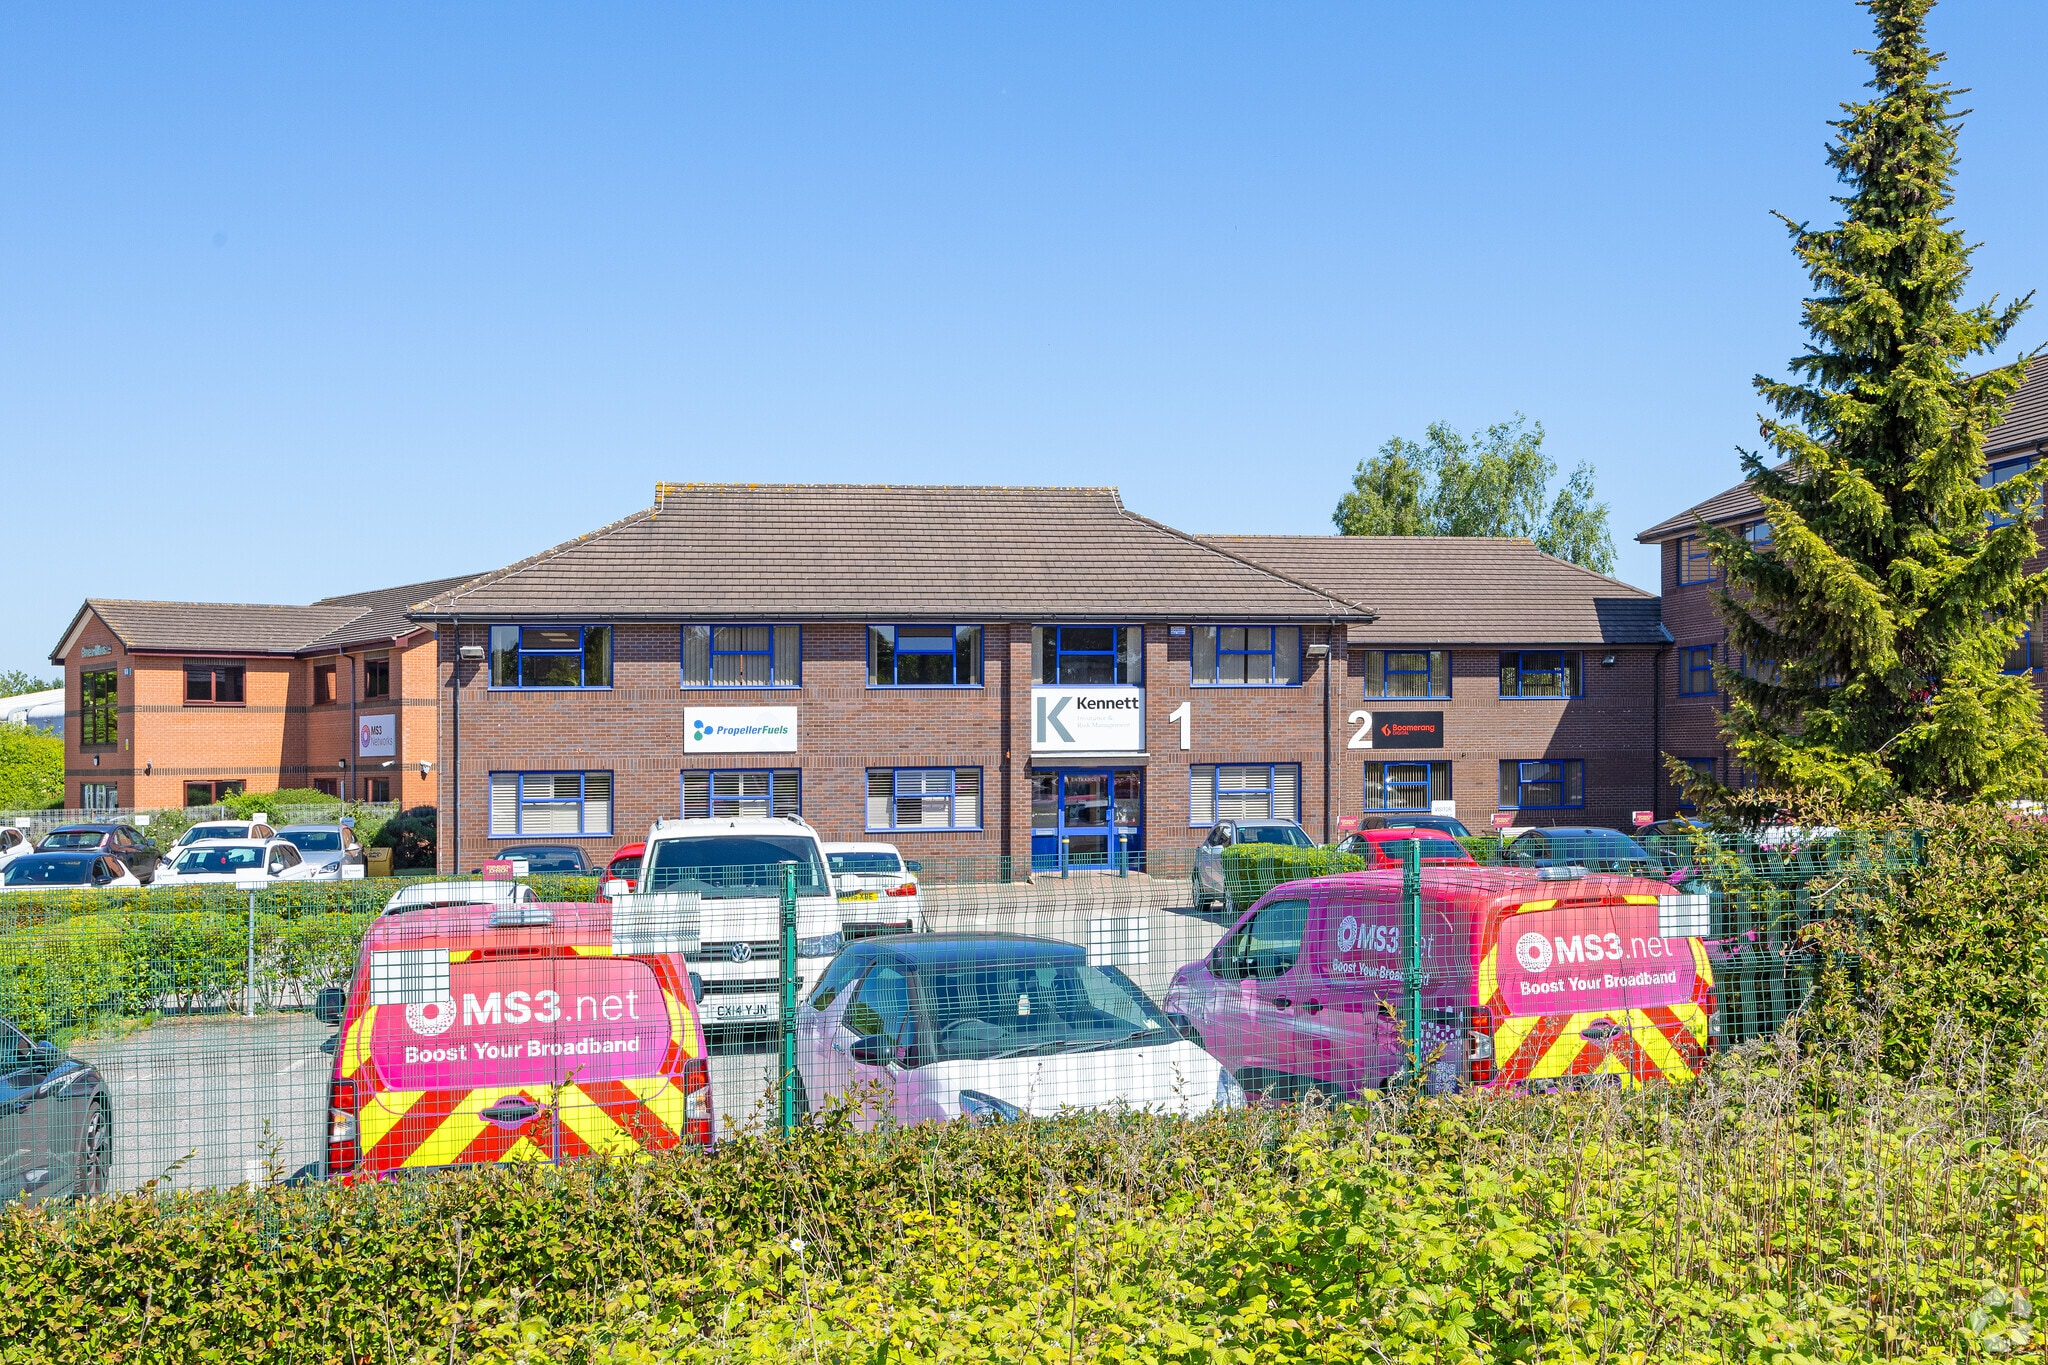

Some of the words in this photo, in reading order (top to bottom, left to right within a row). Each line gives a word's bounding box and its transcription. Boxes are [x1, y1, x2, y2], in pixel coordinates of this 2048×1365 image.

[1077, 697, 1139, 709] Kennett
[371, 725, 383, 735] MS3
[716, 725, 789, 736] PropellerFuels
[1037, 697, 1076, 743] K
[1169, 702, 1191, 750] 1
[1347, 710, 1373, 749] 2
[1392, 724, 1435, 732] Boomerang
[371, 737, 393, 746] Networks
[1357, 923, 1435, 958] MS3.et
[1554, 932, 1674, 964] MS3.net
[1333, 959, 1356, 973] Boost
[1359, 962, 1379, 977] Your
[1520, 979, 1565, 996] Boost
[1568, 976, 1602, 991] Your
[1604, 970, 1677, 989] Broadband
[462, 989, 640, 1027] MS3.net
[717, 1005, 742, 1016] CX14
[745, 1004, 767, 1015] YJN
[405, 1044, 467, 1064] Boost
[473, 1042, 523, 1060] Your
[527, 1035, 640, 1057] Broadband
